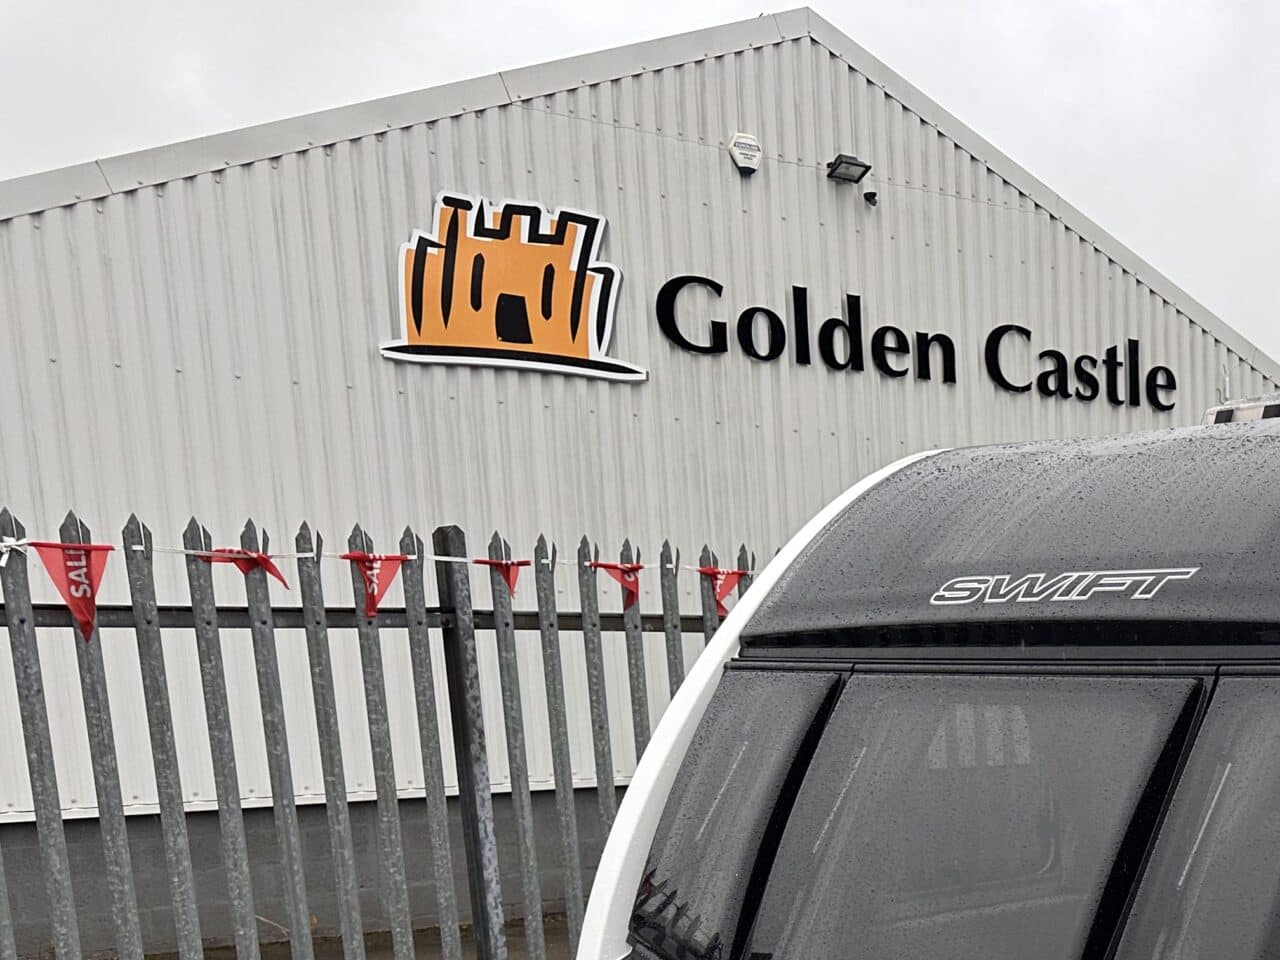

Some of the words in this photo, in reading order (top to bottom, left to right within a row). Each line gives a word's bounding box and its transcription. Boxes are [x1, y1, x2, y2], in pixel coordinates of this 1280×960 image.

[656, 276, 957, 384] Golden
[985, 324, 1177, 412] Castle
[930, 567, 1200, 605] SWIFT
